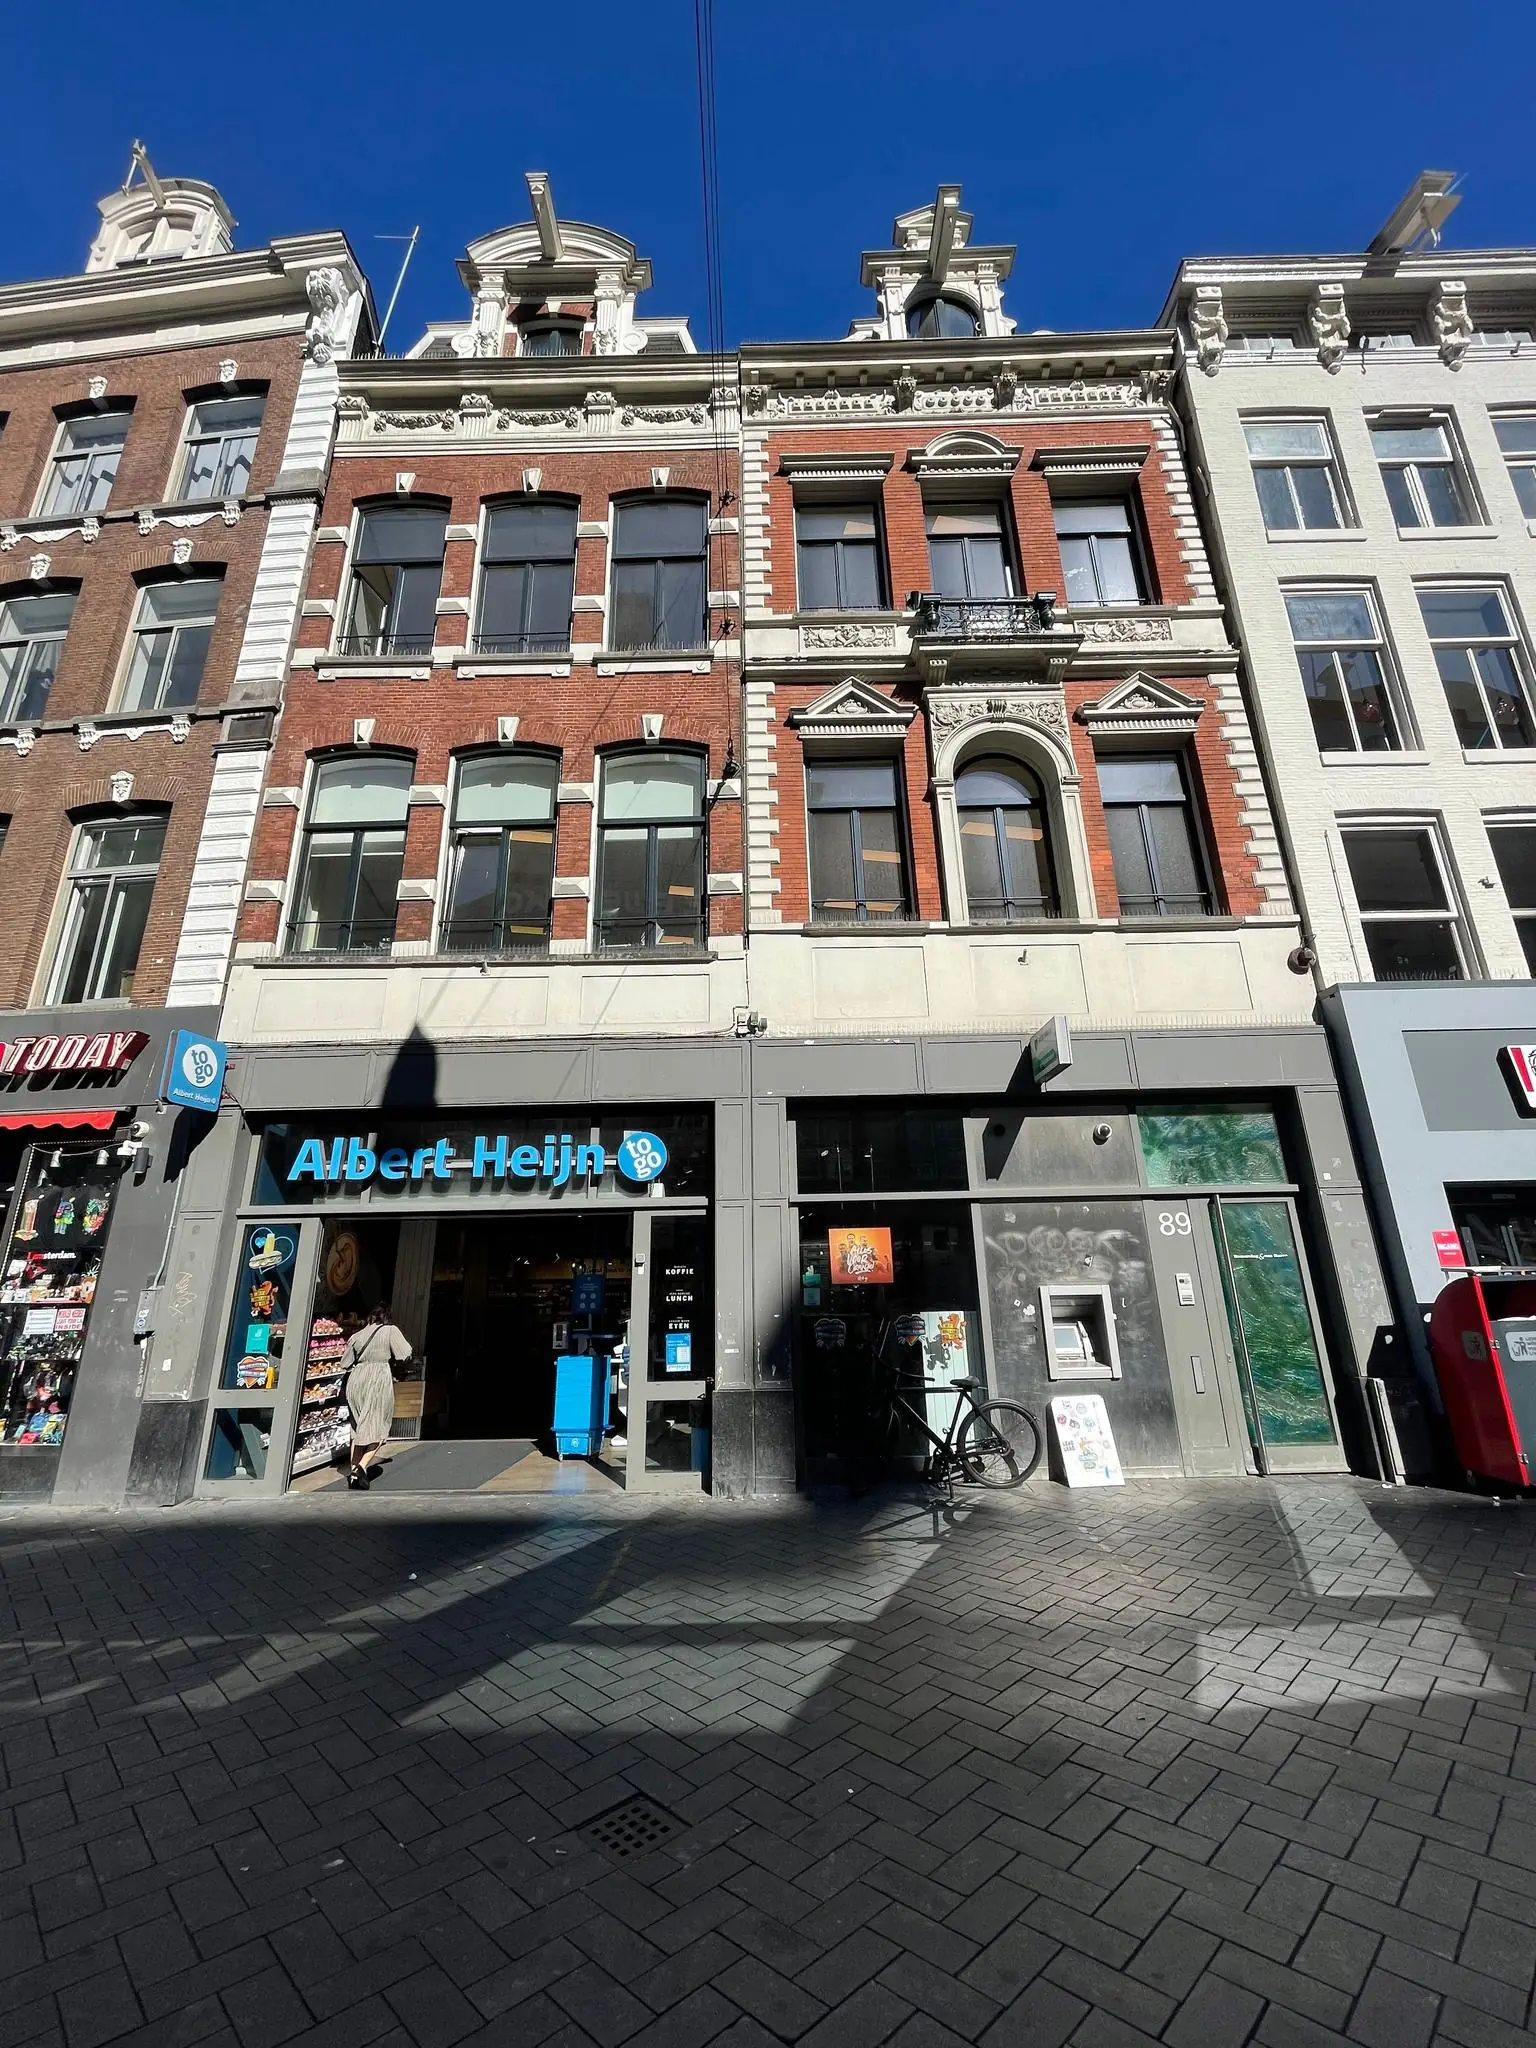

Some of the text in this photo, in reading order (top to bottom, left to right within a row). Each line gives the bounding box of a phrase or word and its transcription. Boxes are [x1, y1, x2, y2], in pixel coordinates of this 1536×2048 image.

[5, 1031, 137, 1072] TODAY
[191, 1049, 208, 1066] to
[195, 1063, 214, 1084] go
[173, 1088, 194, 1099] Albert
[286, 1134, 605, 1186] Albert Heijn
[626, 1138, 652, 1159] to
[633, 1151, 662, 1179] go
[1158, 1211, 1192, 1236] 89
